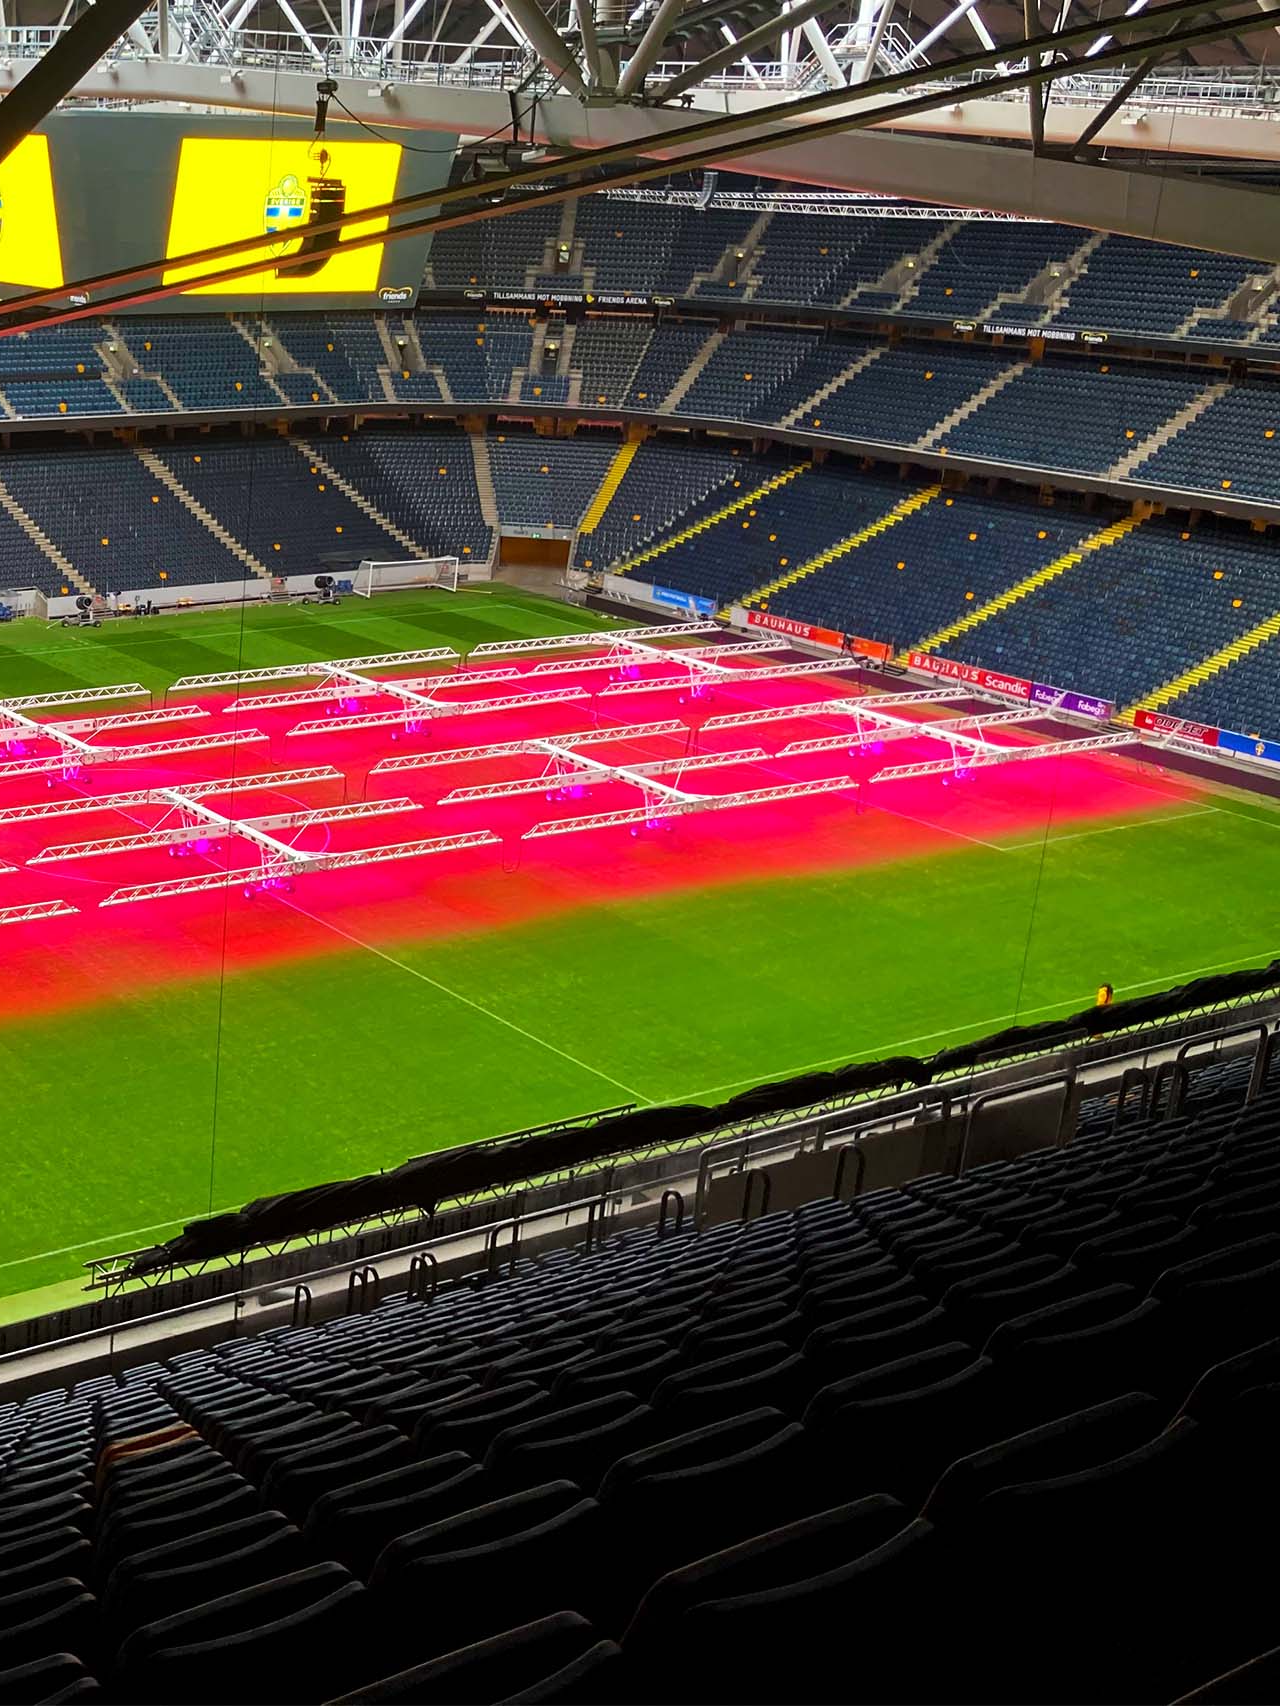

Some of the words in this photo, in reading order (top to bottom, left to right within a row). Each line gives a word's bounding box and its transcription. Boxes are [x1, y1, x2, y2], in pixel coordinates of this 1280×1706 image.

[382, 290, 408, 300] friends
[493, 291, 536, 301] TILLSAMMANS
[536, 294, 550, 302] MOT
[597, 295, 625, 304] FRIENDS
[625, 297, 648, 305] ARENA
[982, 324, 1026, 337] TILLSAMMANS
[1026, 328, 1041, 338] MOT
[1041, 330, 1076, 341] MOBBNING
[754, 613, 811, 638] BAUHAUS
[913, 654, 979, 682] BAUHAUS
[984, 675, 1028, 697] Scandic
[1034, 689, 1058, 705] Fabeg
